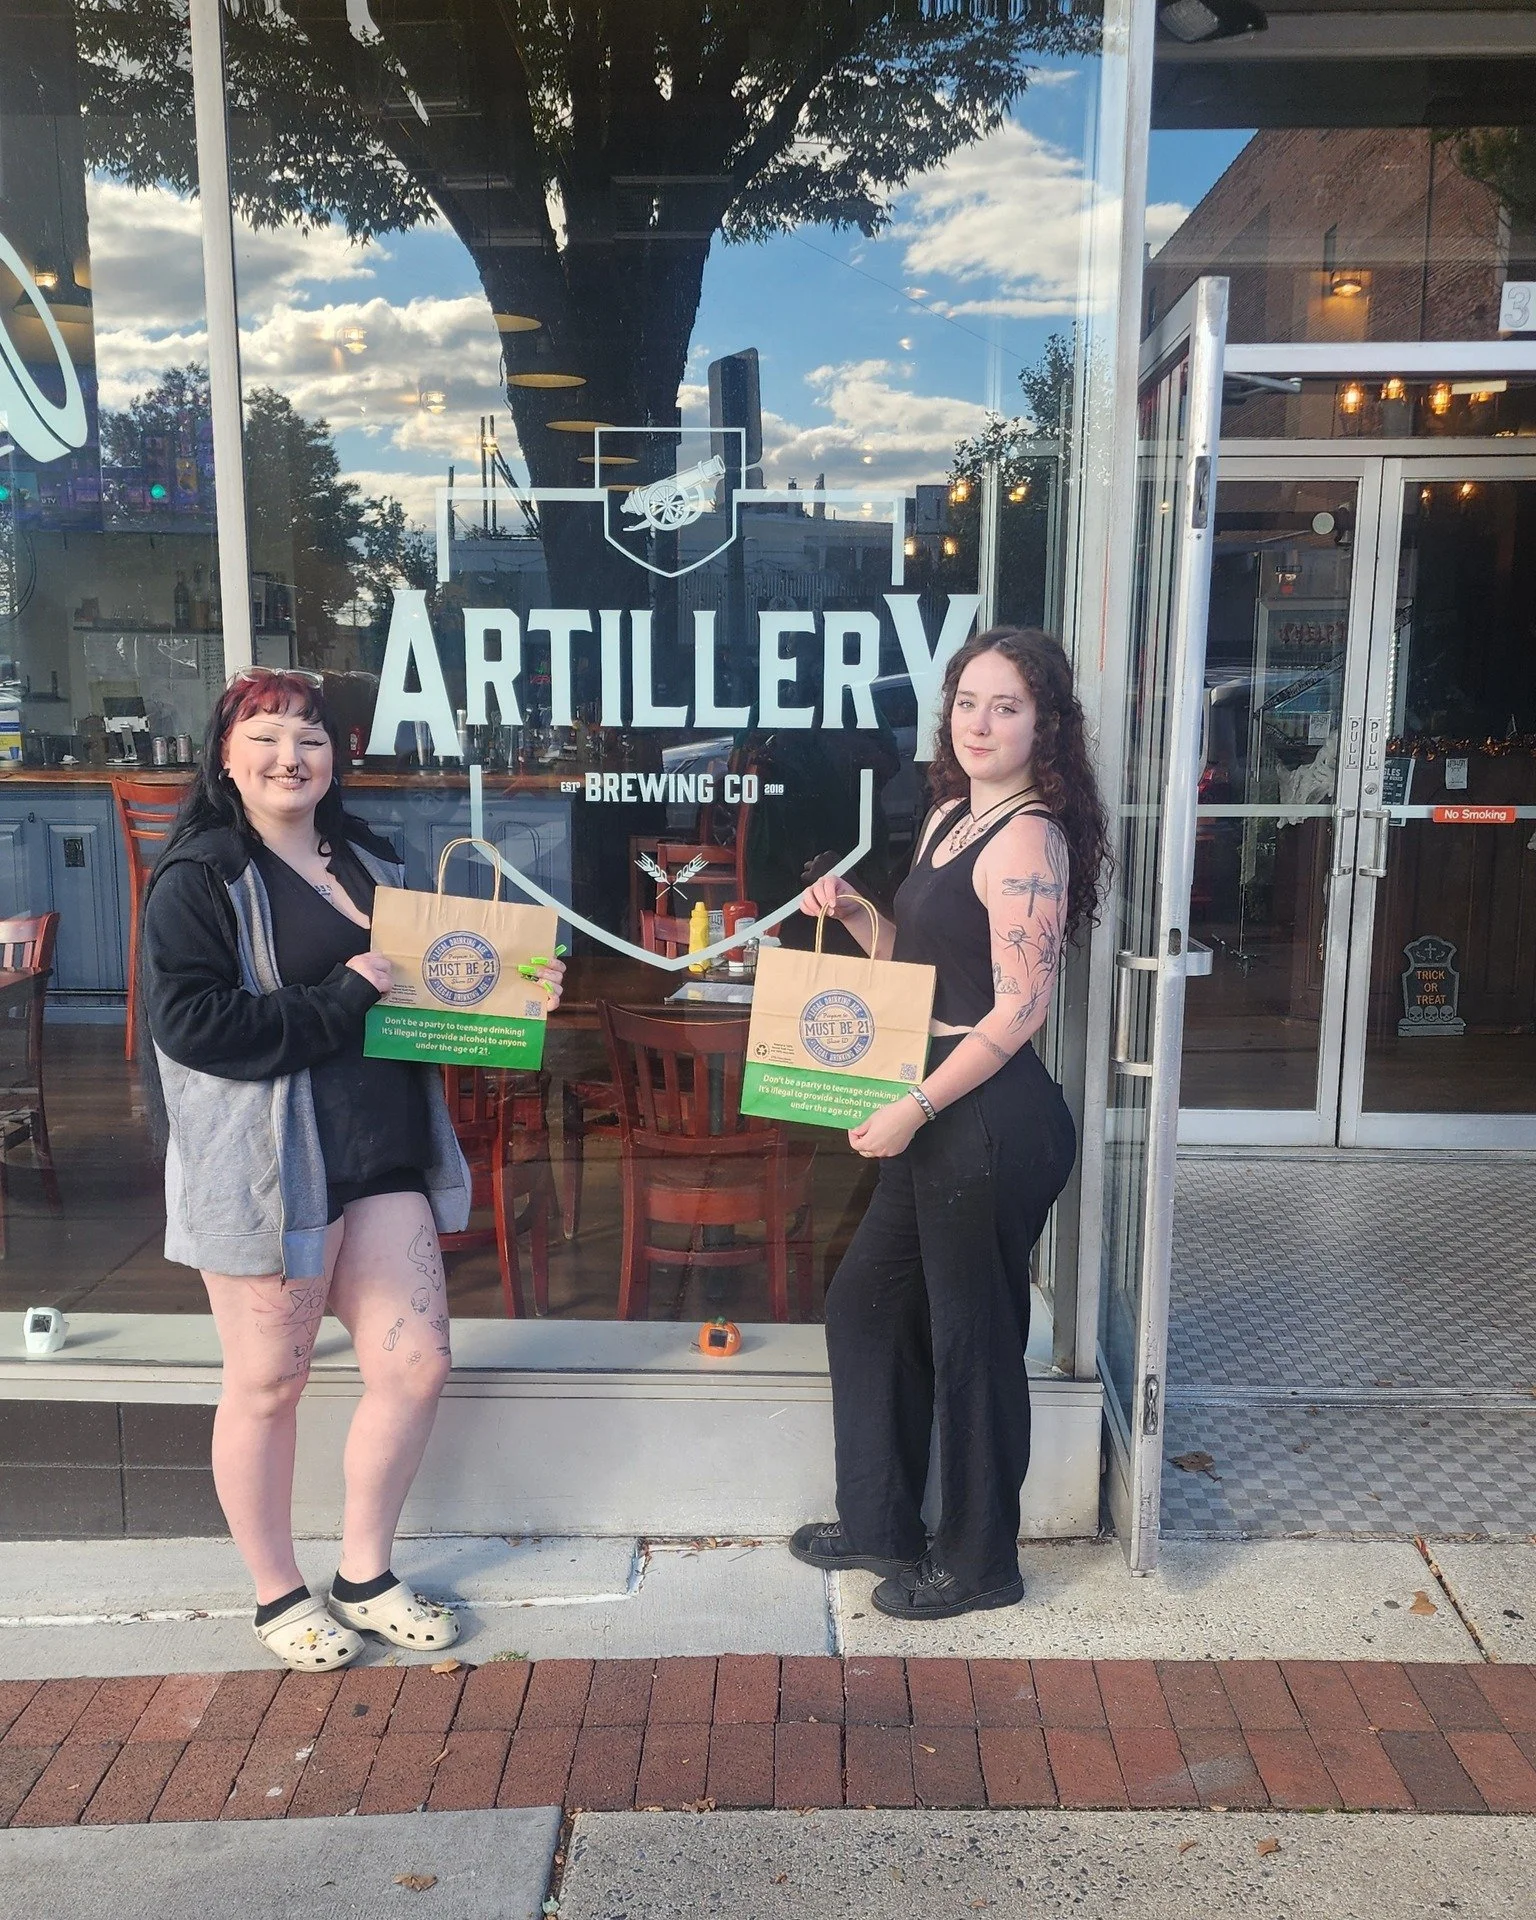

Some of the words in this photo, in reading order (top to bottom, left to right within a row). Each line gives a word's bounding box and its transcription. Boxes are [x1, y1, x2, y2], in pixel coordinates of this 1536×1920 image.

[365, 589, 983, 762] ARTILLERY
[1349, 721, 1359, 766] PULL
[1368, 722, 1379, 767] PULL
[585, 772, 714, 803] BREWING
[724, 774, 758, 803] CO
[764, 784, 784, 796] 2018
[1444, 809, 1459, 820] No
[1461, 808, 1507, 821] Smoking
[428, 963, 461, 977] MUST
[466, 962, 479, 975] BE
[483, 960, 495, 974] 21
[1416, 970, 1445, 980] TRICK
[1424, 982, 1438, 992] OR
[1416, 994, 1446, 1005] TREAT
[384, 1016, 407, 1026] Don't
[407, 1018, 418, 1027] be
[424, 1021, 446, 1031] party
[446, 1022, 456, 1030] to
[456, 1024, 489, 1035] teenage
[489, 1026, 525, 1038] drinking!
[805, 1022, 836, 1037] MUST
[840, 1021, 854, 1035] BE
[857, 1020, 870, 1034] 21
[381, 1027, 393, 1036] It's
[393, 1027, 418, 1039] illegal
[428, 1032, 459, 1042] provide
[458, 1034, 488, 1044] alcohol
[488, 1037, 498, 1045] to
[497, 1039, 527, 1048] anyone
[415, 1042, 439, 1050] under
[439, 1043, 453, 1052] the
[453, 1046, 468, 1055] age
[469, 1046, 478, 1054] of
[758, 1084, 770, 1094] It's
[770, 1086, 794, 1098] illegal
[794, 1090, 803, 1098] to
[803, 1092, 834, 1103] provide
[833, 1096, 862, 1107] alcohol
[863, 1100, 872, 1108] to
[763, 1074, 785, 1085] Don't
[785, 1076, 795, 1086] be
[801, 1081, 822, 1091] party
[822, 1083, 831, 1091] to
[831, 1085, 863, 1097] teenage
[863, 1088, 900, 1102] drinking!
[790, 1102, 814, 1111] under
[814, 1103, 827, 1113] the
[827, 1107, 843, 1116] age
[843, 1108, 852, 1116] of
